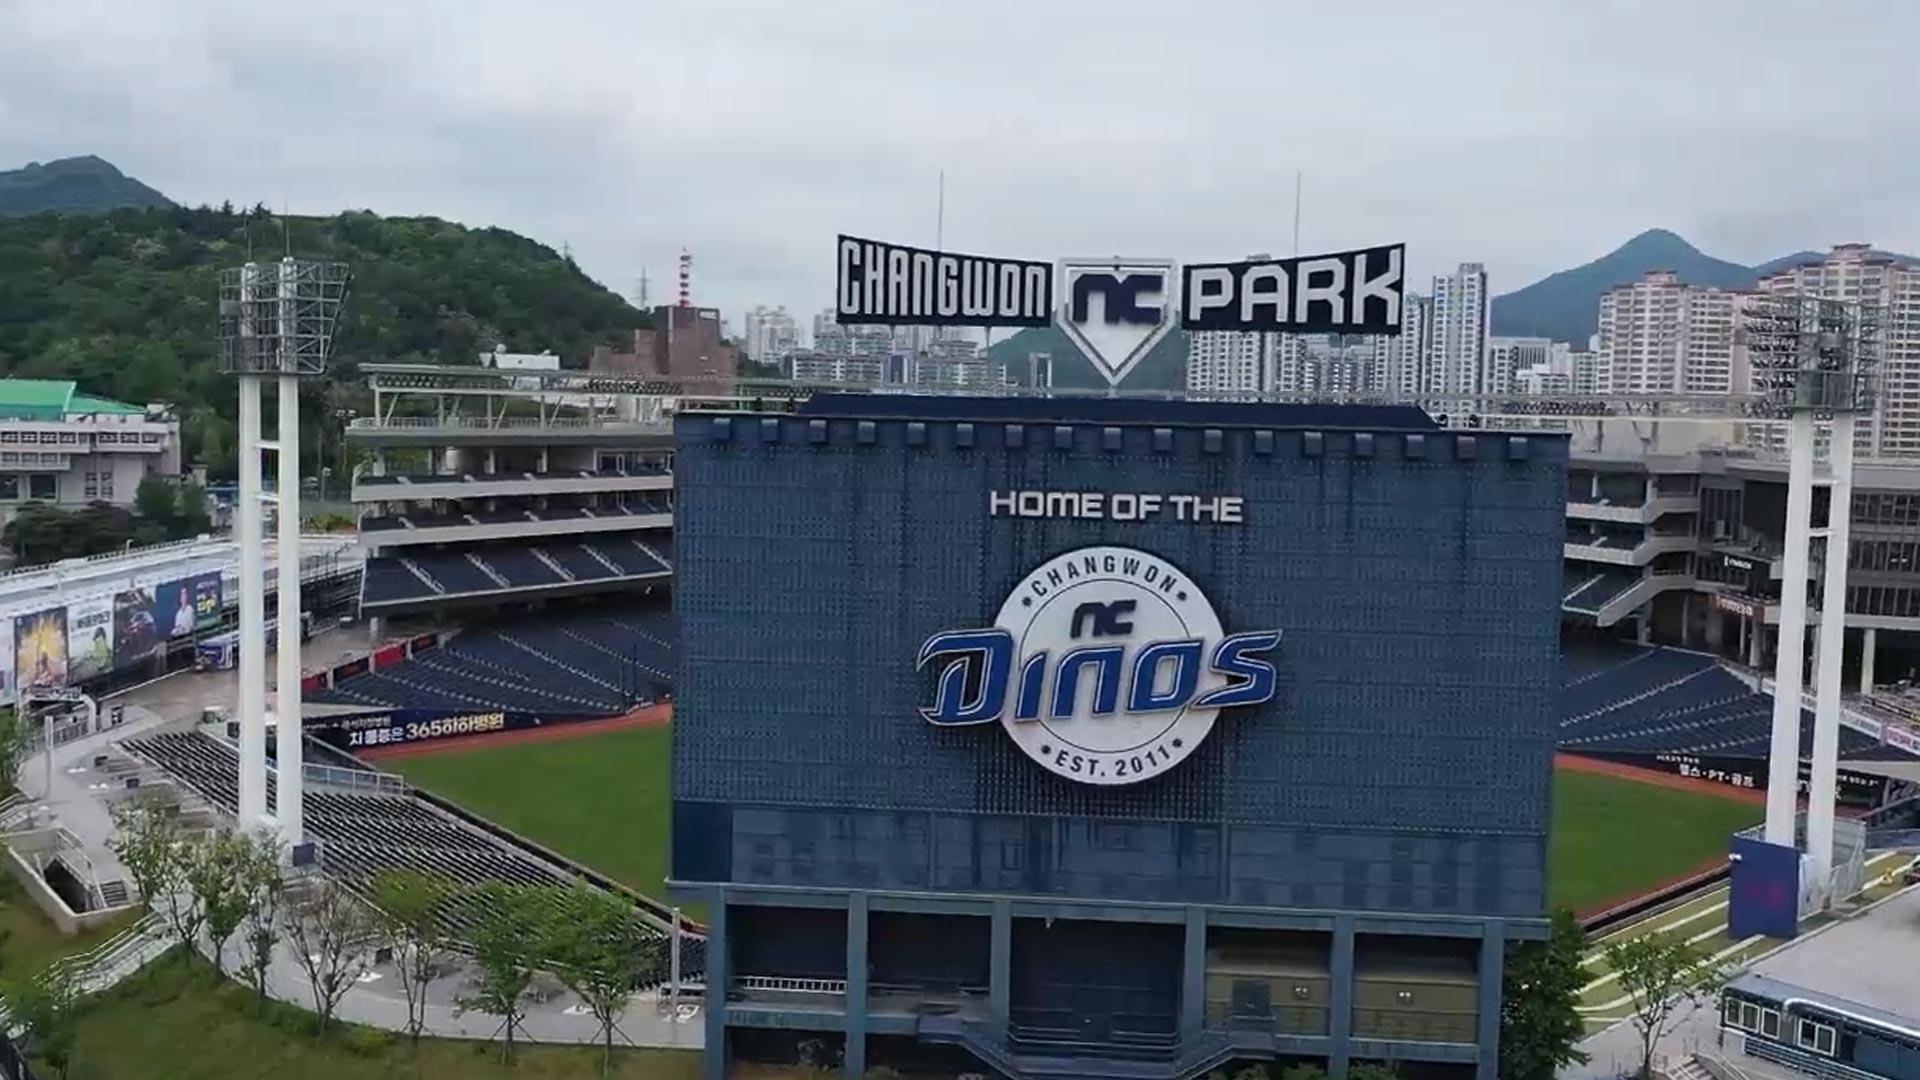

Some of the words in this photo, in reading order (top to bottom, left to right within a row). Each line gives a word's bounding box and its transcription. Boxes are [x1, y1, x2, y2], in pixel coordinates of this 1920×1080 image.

[839, 239, 1046, 317] CHANGWON
[1189, 248, 1399, 325] PARK
[990, 490, 1104, 518] HOME
[1111, 493, 1162, 520] OF
[1169, 495, 1243, 522] THE
[1031, 555, 1177, 597] CHANGWON
[1055, 749, 1105, 775] EST.
[1115, 745, 1170, 776] 2011
